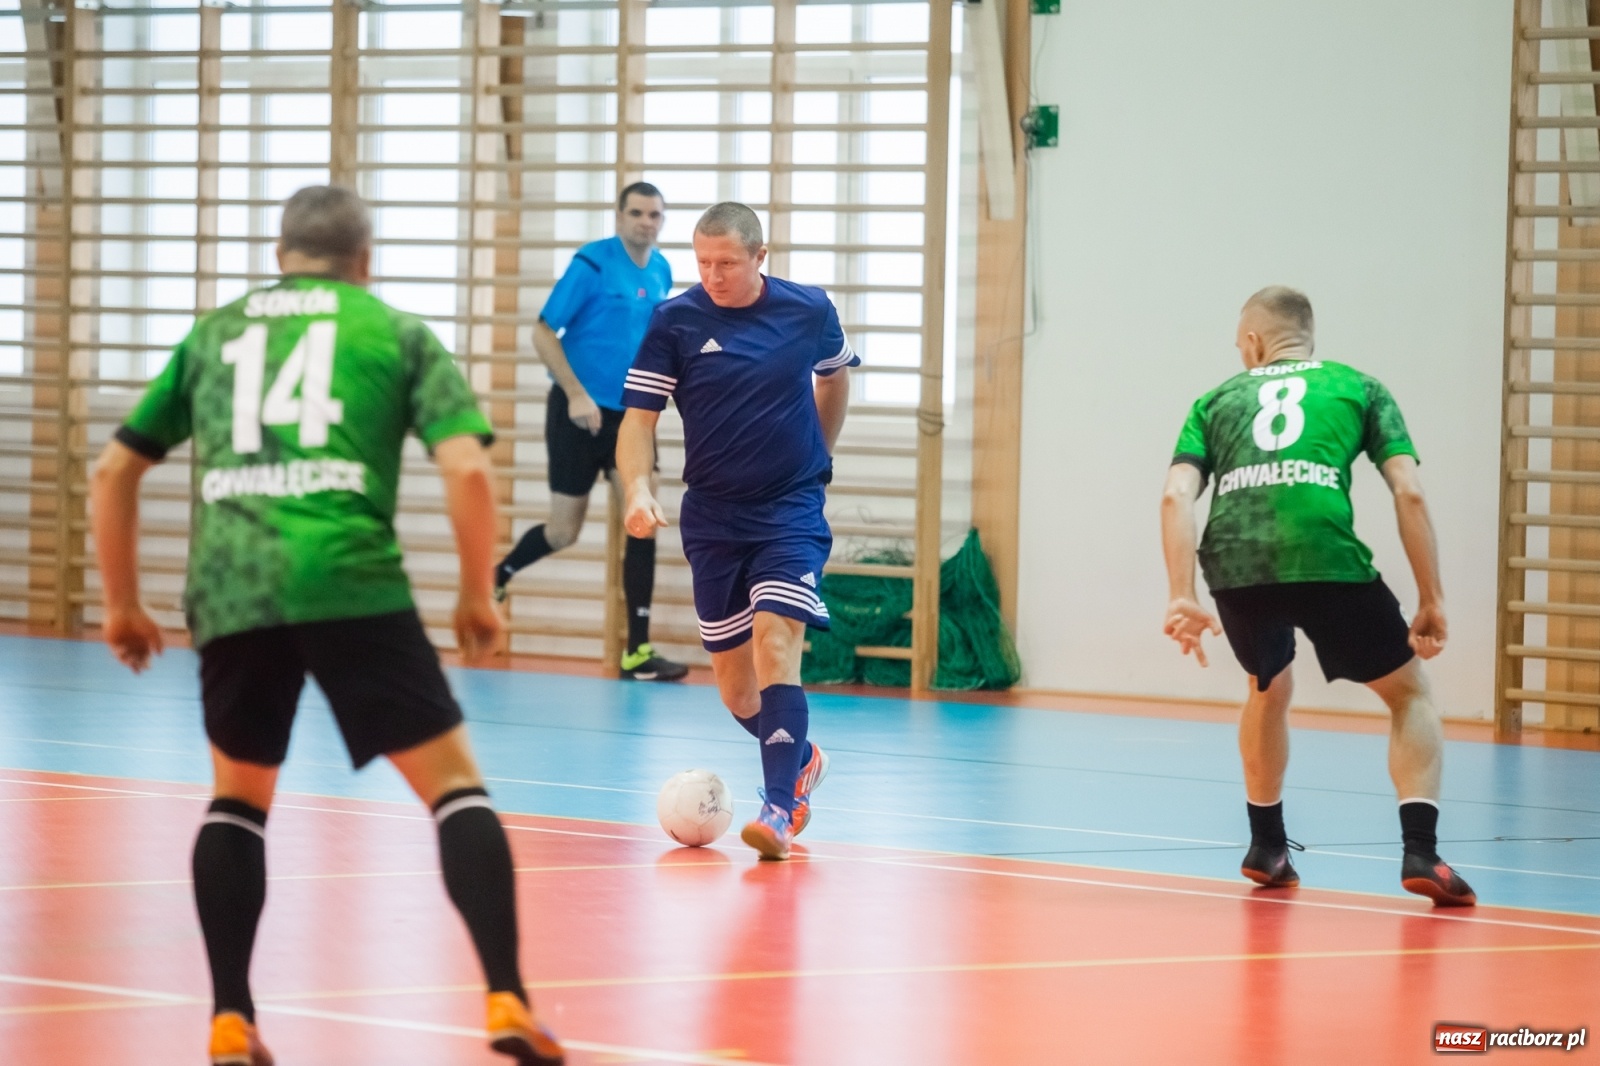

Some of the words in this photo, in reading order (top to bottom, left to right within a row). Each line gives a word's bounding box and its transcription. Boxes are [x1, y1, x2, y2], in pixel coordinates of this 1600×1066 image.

[221, 320, 343, 454] 14
[1252, 376, 1307, 451] 8
[1217, 459, 1341, 497] CHWAŁĘCICE
